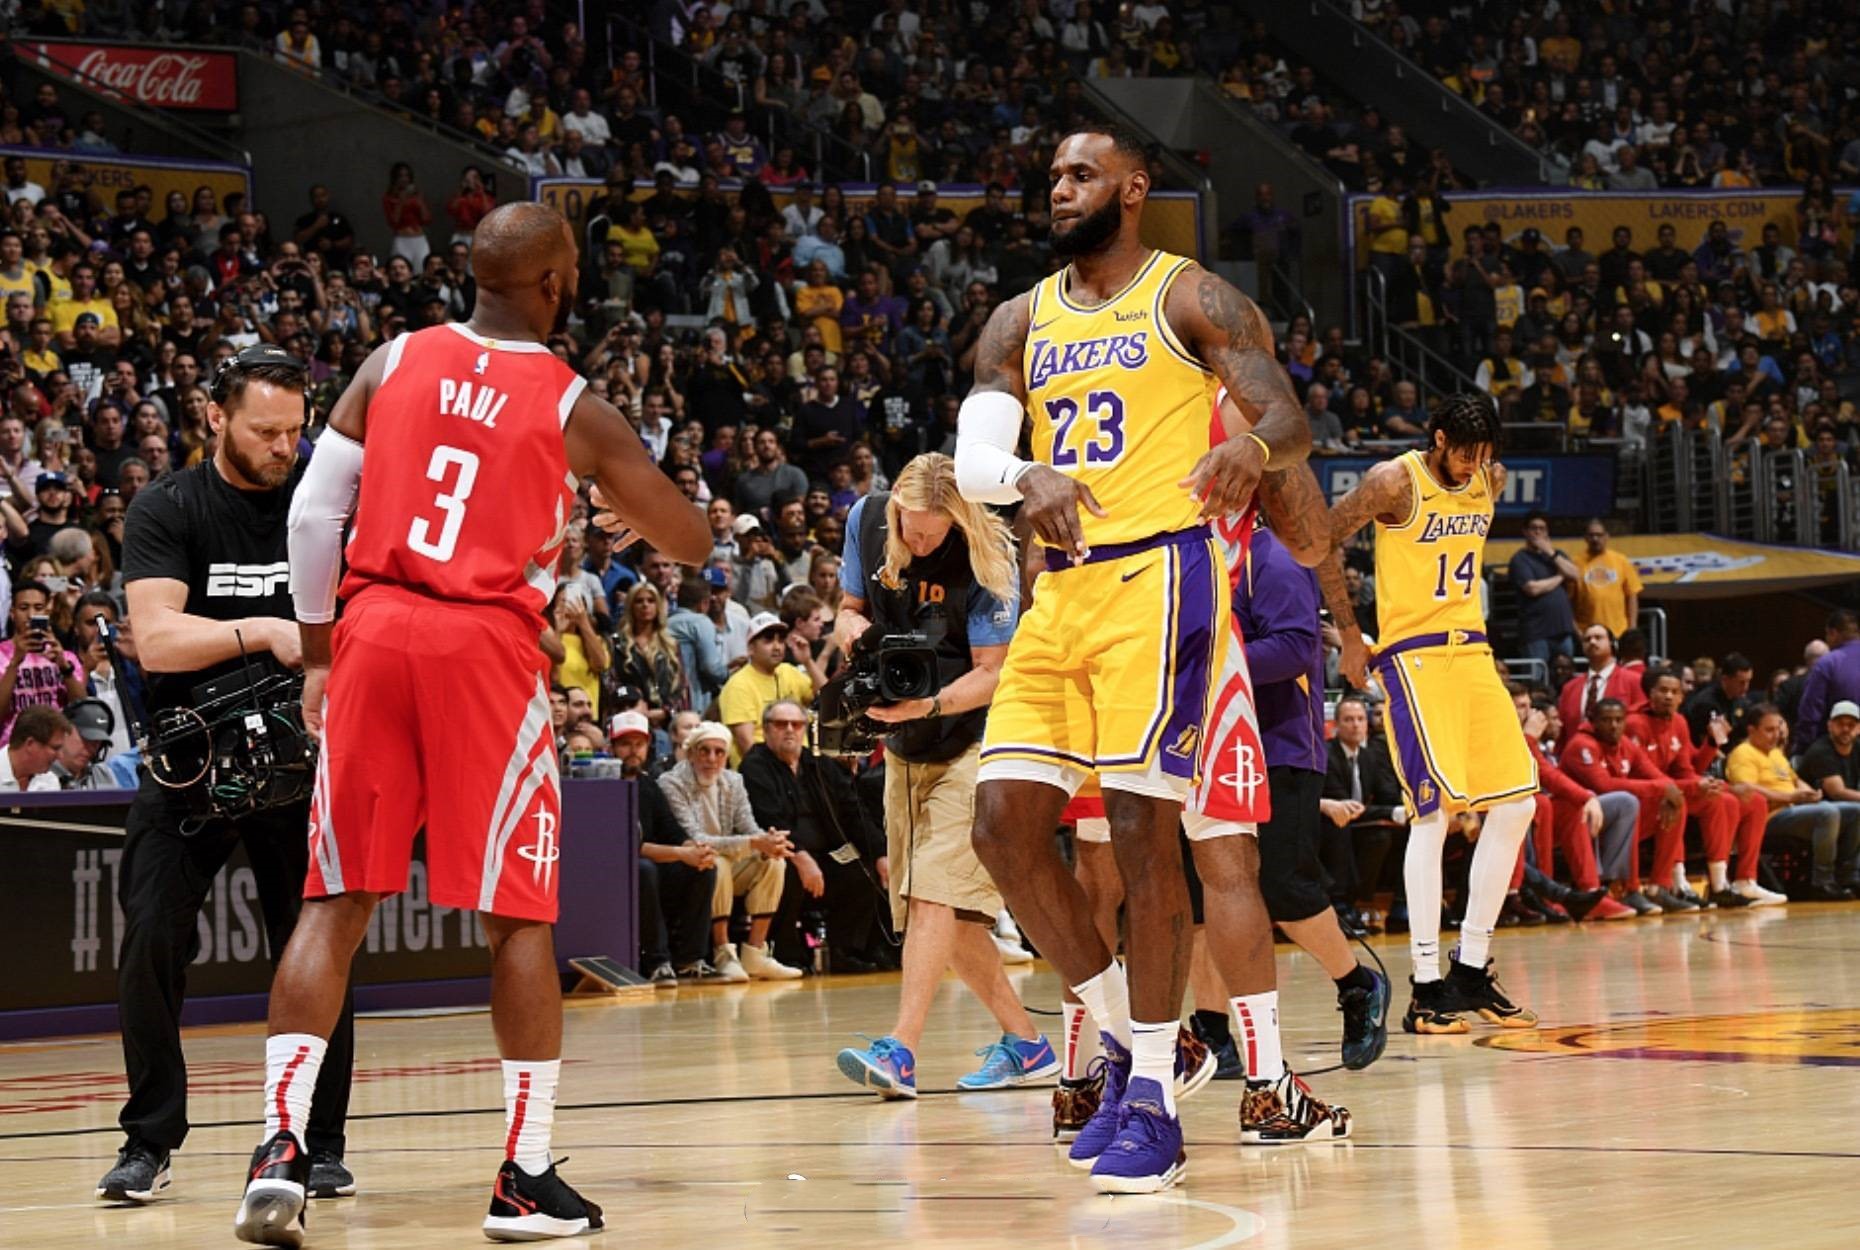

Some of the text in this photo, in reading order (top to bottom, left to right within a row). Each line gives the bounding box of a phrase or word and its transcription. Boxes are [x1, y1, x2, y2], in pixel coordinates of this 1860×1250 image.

[1483, 202, 1574, 220] @LAKERS
[1649, 201, 1765, 219] LAKERS.COM
[1028, 331, 1149, 391] LAKERS
[439, 377, 509, 428] PAUL
[1044, 390, 1125, 468] 23
[407, 445, 480, 563] 3
[1416, 512, 1491, 543] LAKERS
[207, 561, 289, 597] ESP
[1433, 551, 1475, 599] 14
